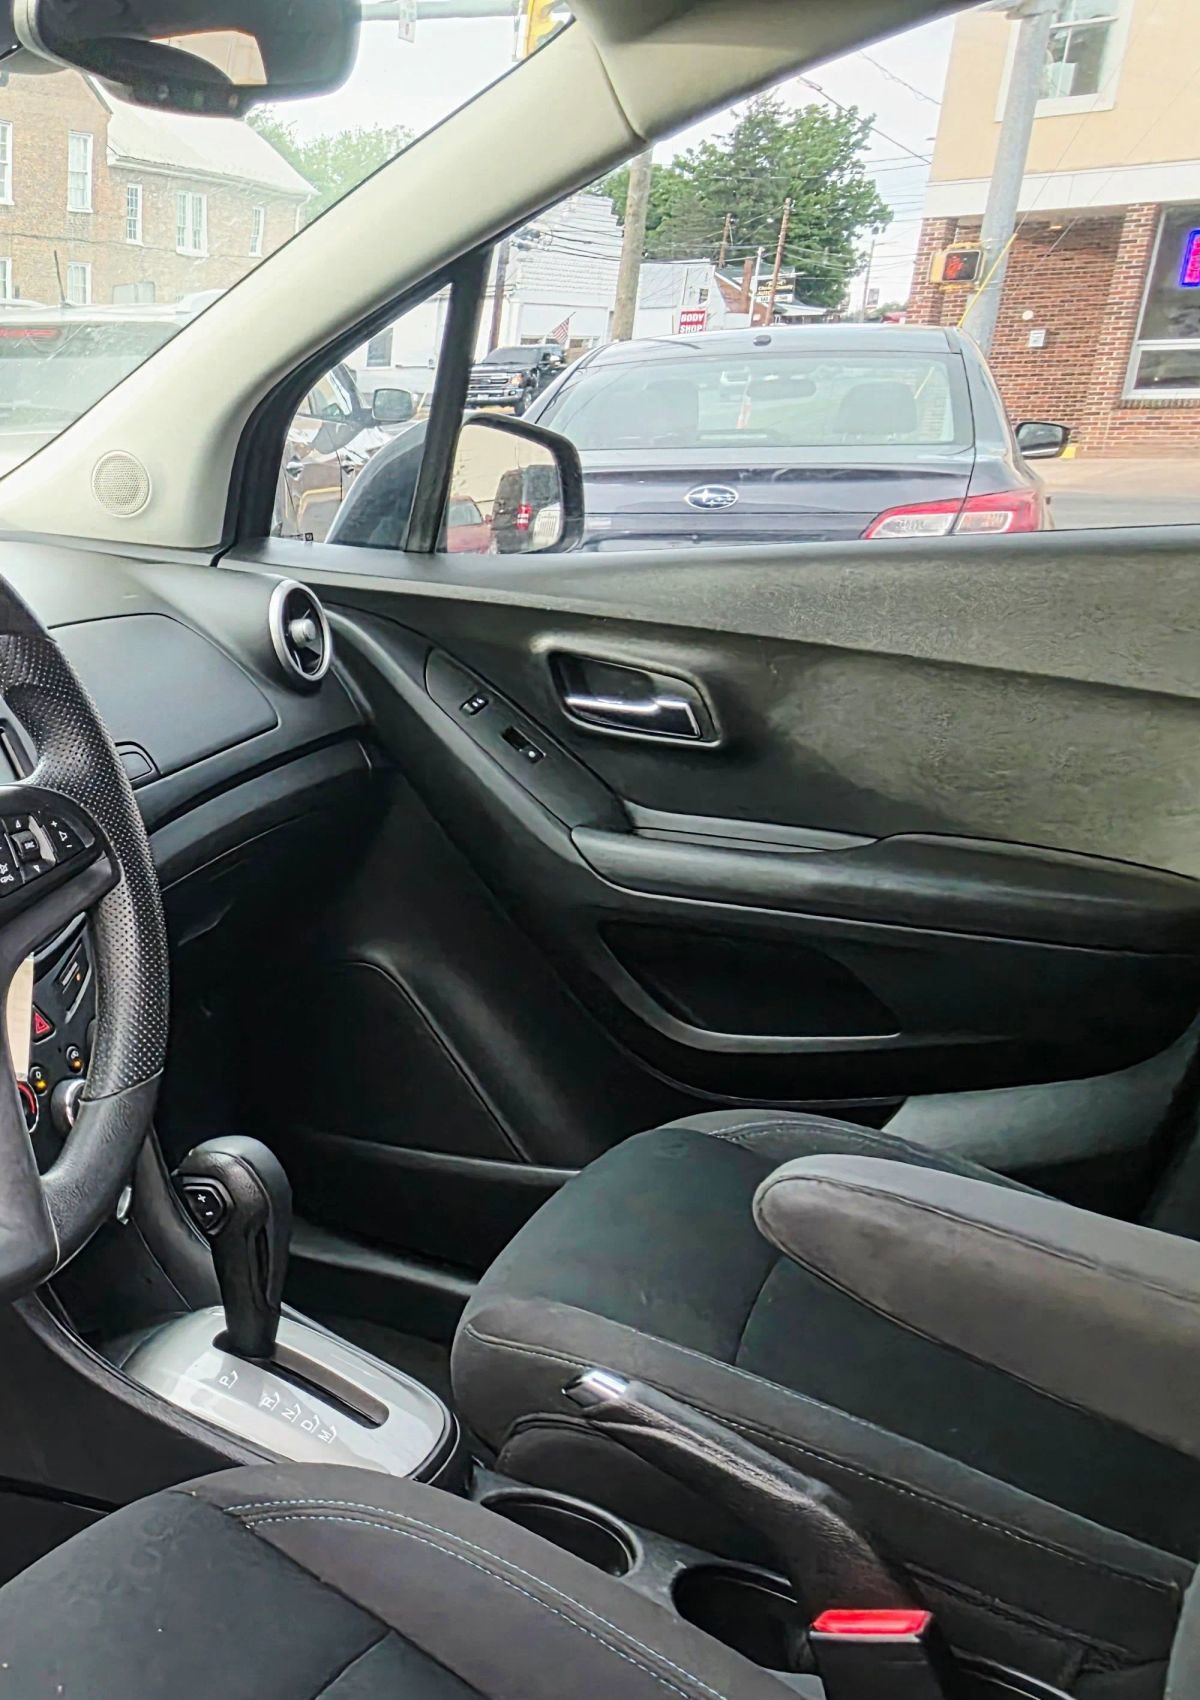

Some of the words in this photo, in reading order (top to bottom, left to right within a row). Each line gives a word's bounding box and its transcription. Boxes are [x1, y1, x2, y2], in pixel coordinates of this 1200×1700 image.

[680, 314, 705, 322] BODY
[679, 325, 703, 333] SHOP
[218, 1375, 230, 1387] P
[281, 1408, 296, 1421] N
[300, 1419, 314, 1432] D
[317, 1429, 332, 1443] M
